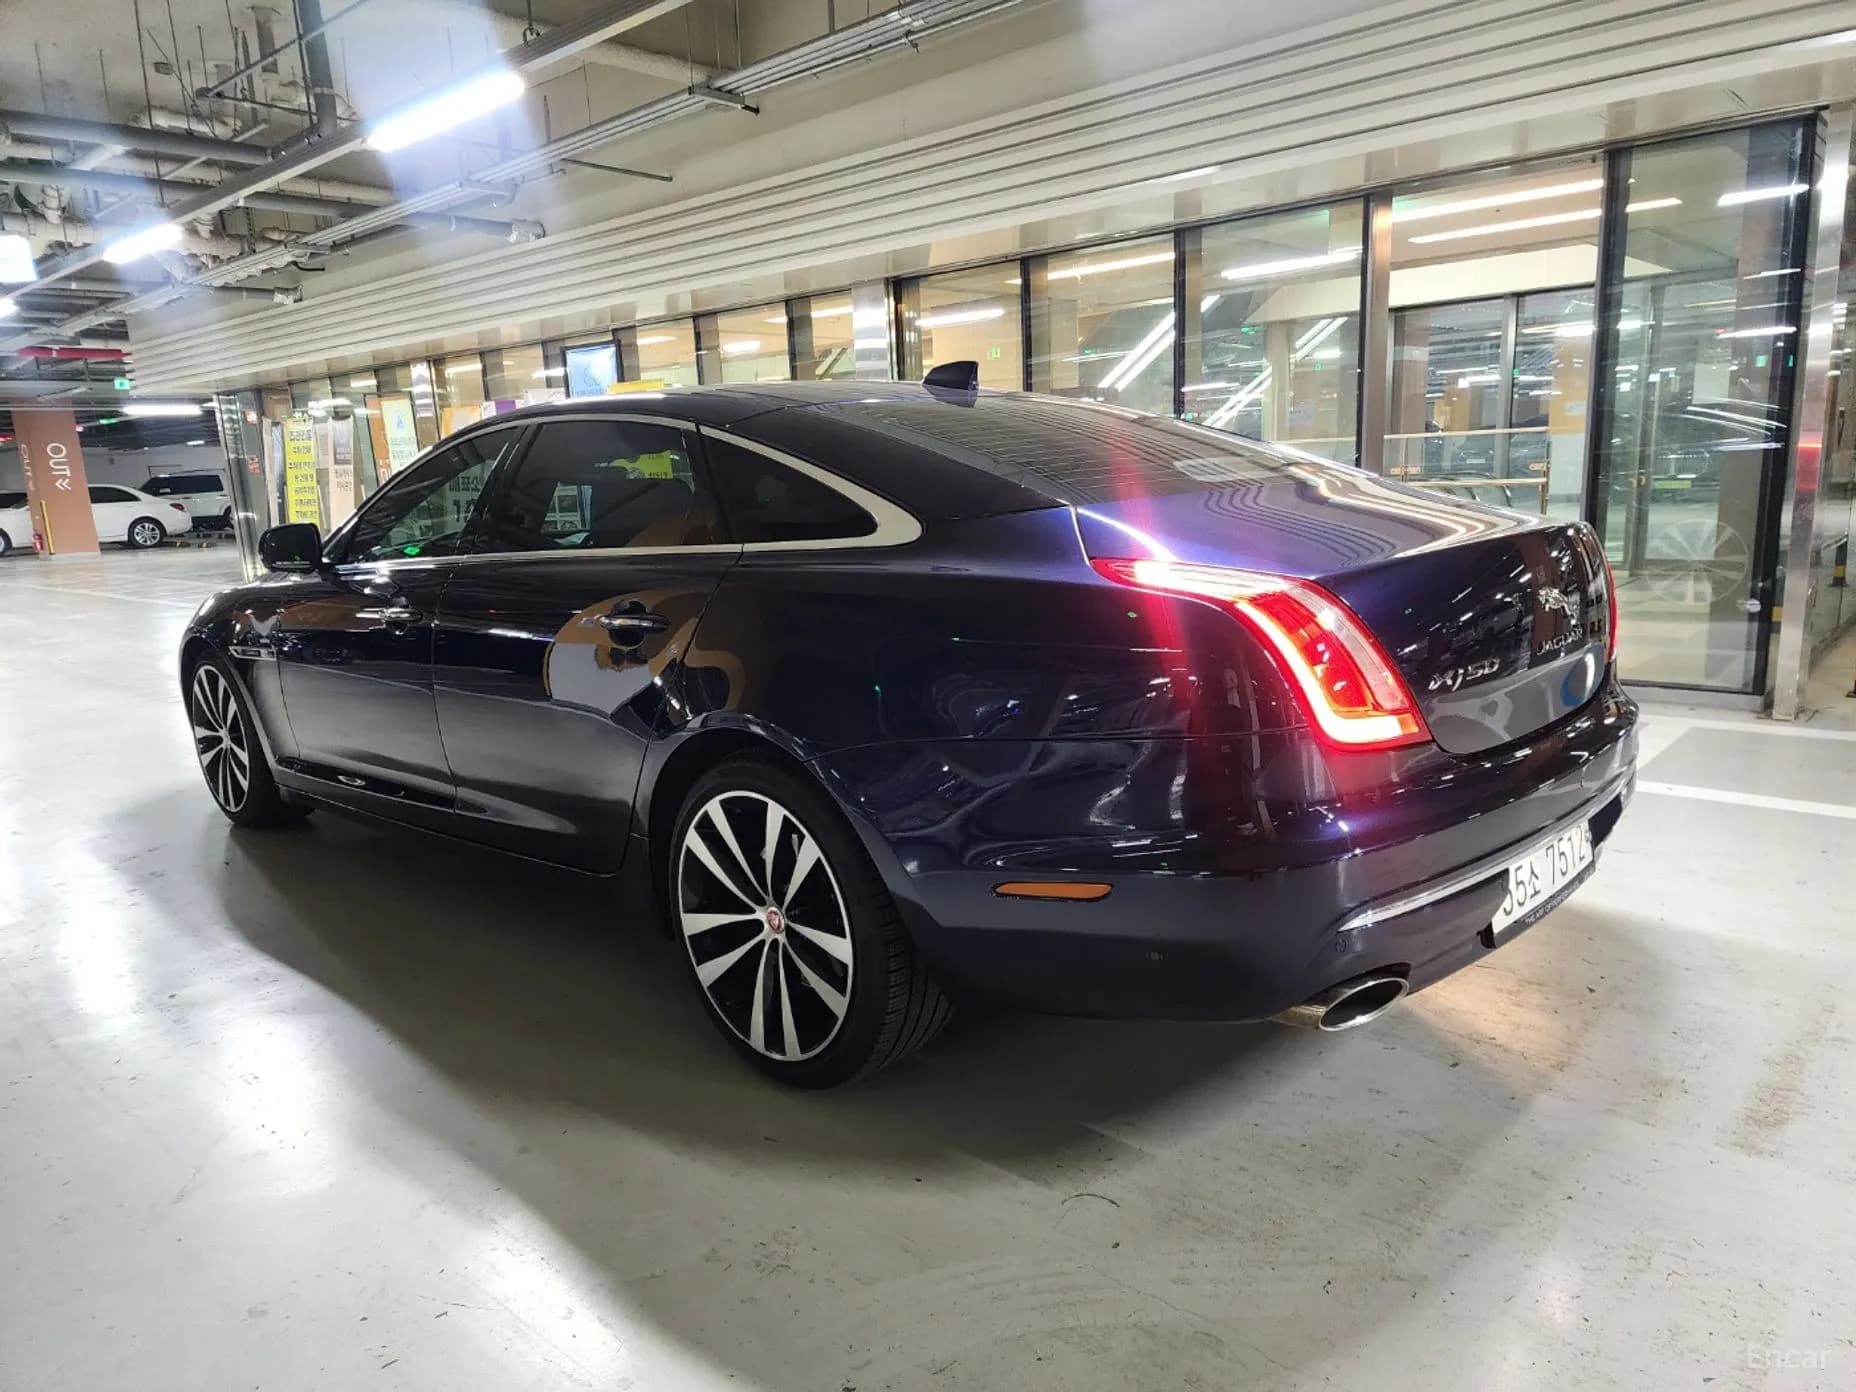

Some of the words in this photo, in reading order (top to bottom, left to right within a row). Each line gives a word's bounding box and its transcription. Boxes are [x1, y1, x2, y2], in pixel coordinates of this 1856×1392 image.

[46, 442, 71, 477] OUT
[1536, 628, 1583, 656] JAGUAR
[1546, 823, 1586, 886] 7512
